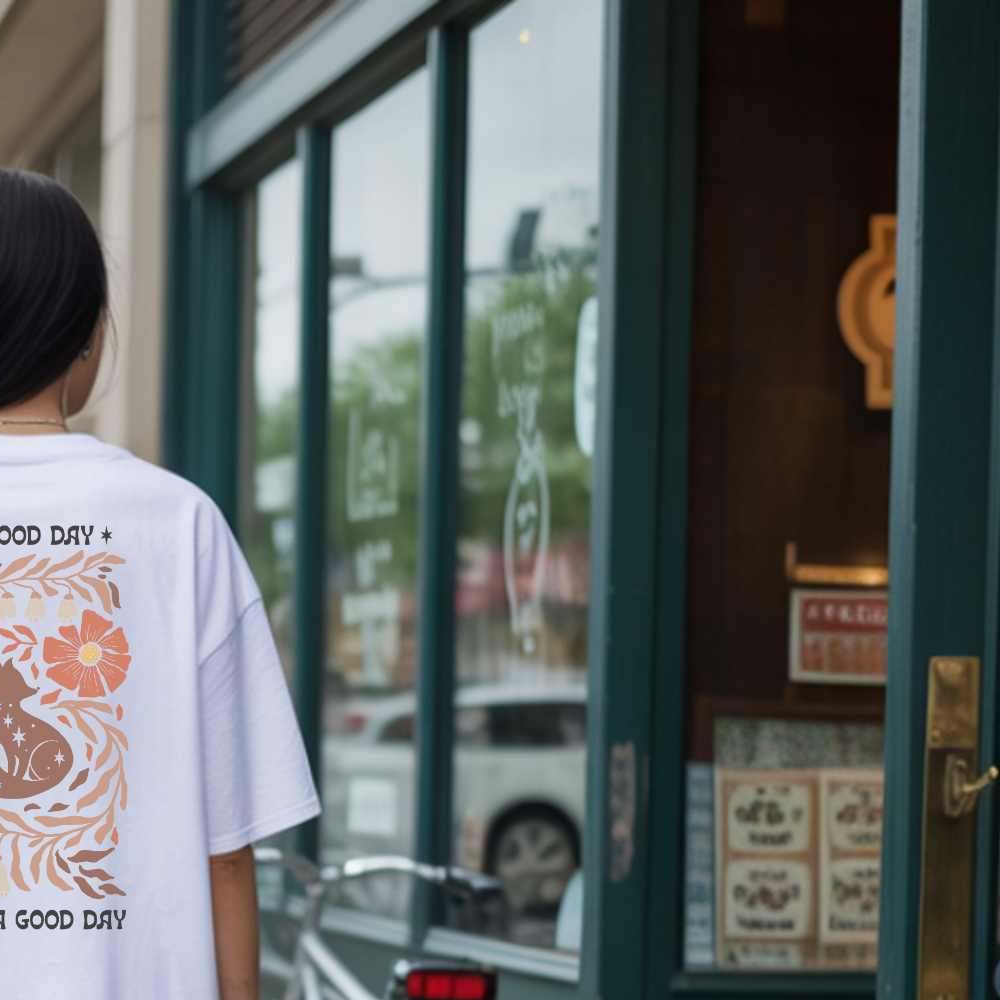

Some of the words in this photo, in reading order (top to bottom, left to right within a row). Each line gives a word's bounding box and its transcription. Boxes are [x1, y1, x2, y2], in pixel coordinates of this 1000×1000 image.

[50, 525, 95, 546] DAY
[15, 909, 74, 930] GOOD
[82, 909, 127, 930] DAY
